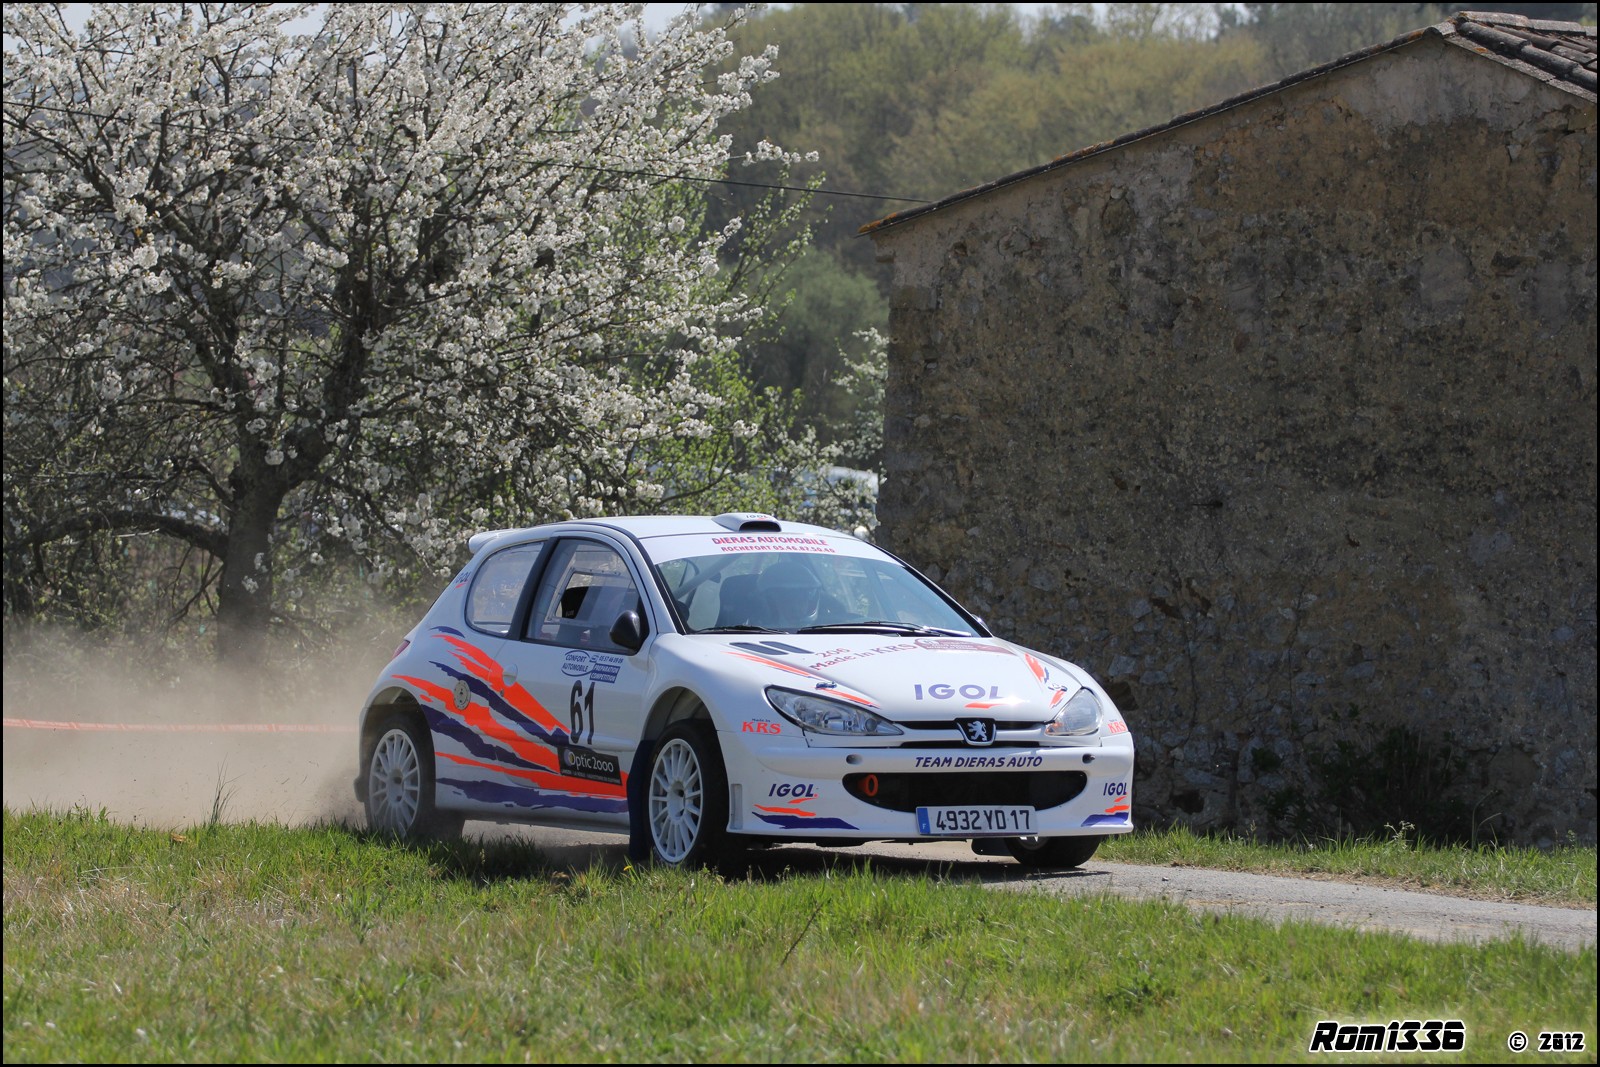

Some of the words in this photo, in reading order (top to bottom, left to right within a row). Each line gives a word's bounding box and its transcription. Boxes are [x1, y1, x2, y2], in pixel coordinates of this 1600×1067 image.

[711, 536, 756, 545] DIERAS
[757, 536, 829, 546] AUTOMOBILE
[565, 654, 587, 662] CONFORT
[809, 656, 856, 671] Made
[870, 644, 918, 654] KRS
[815, 647, 851, 658] 206
[562, 662, 589, 672] AUTOMOBILE
[914, 684, 1005, 700] IGOL
[570, 680, 595, 745] 61
[742, 722, 781, 734] KRS
[1108, 722, 1127, 734] KRS
[568, 752, 592, 770] Optic
[592, 756, 614, 772] 2000
[915, 756, 952, 768] TEAM
[954, 756, 1005, 768] DIERAS
[1006, 756, 1043, 768] AUTO
[769, 784, 814, 798] IGOL
[1103, 782, 1127, 796] IGOL
[936, 810, 982, 830] 4932
[1010, 810, 1030, 830] 17
